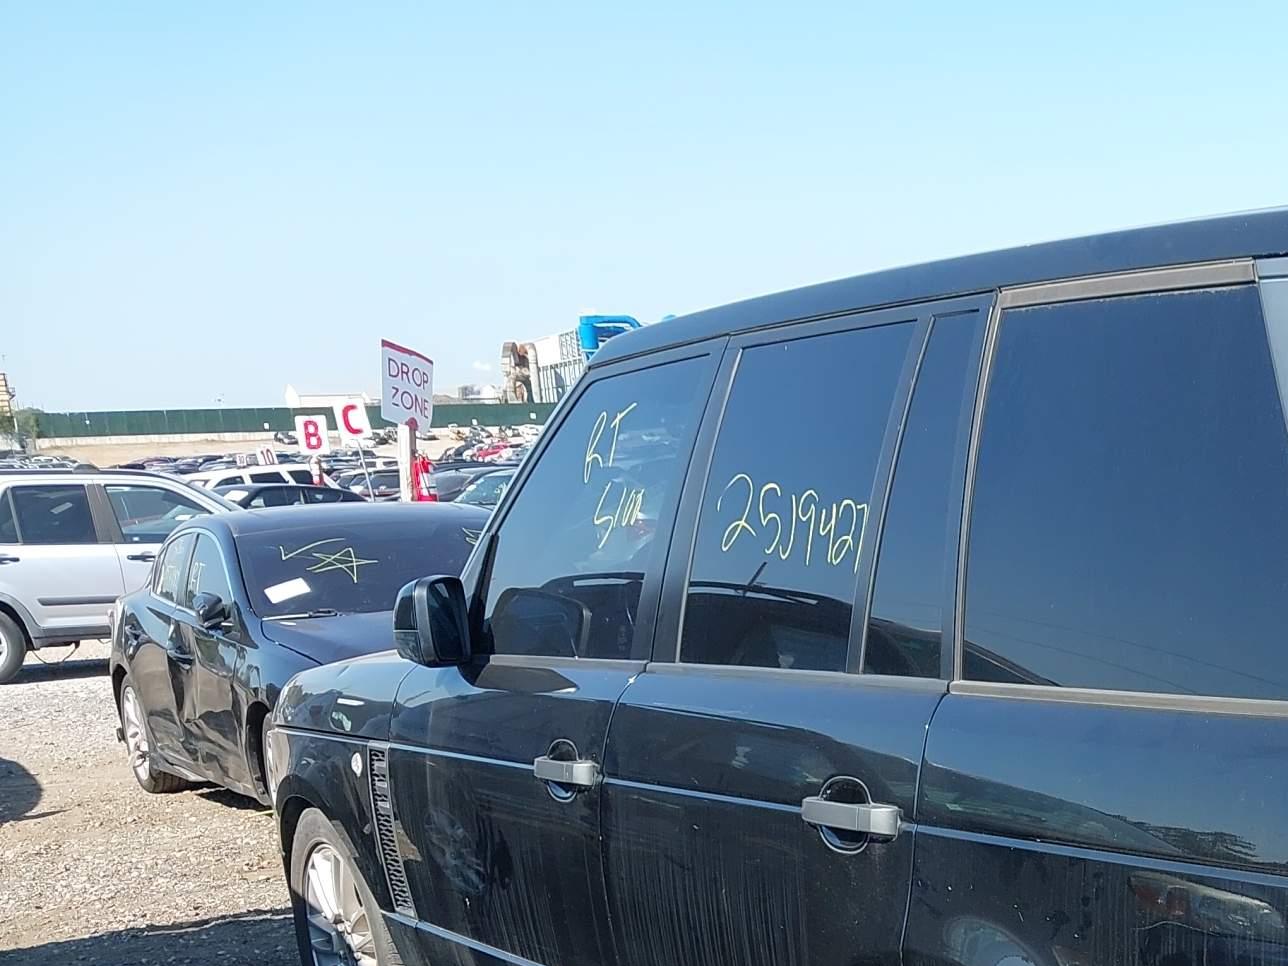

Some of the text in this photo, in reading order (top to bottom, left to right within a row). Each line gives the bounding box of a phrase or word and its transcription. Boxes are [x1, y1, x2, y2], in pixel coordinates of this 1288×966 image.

[387, 357, 429, 390] DROP
[391, 386, 429, 419] ZONE
[303, 420, 323, 450] B
[341, 404, 364, 435] C
[260, 448, 275, 465] 10
[583, 402, 638, 483] RT
